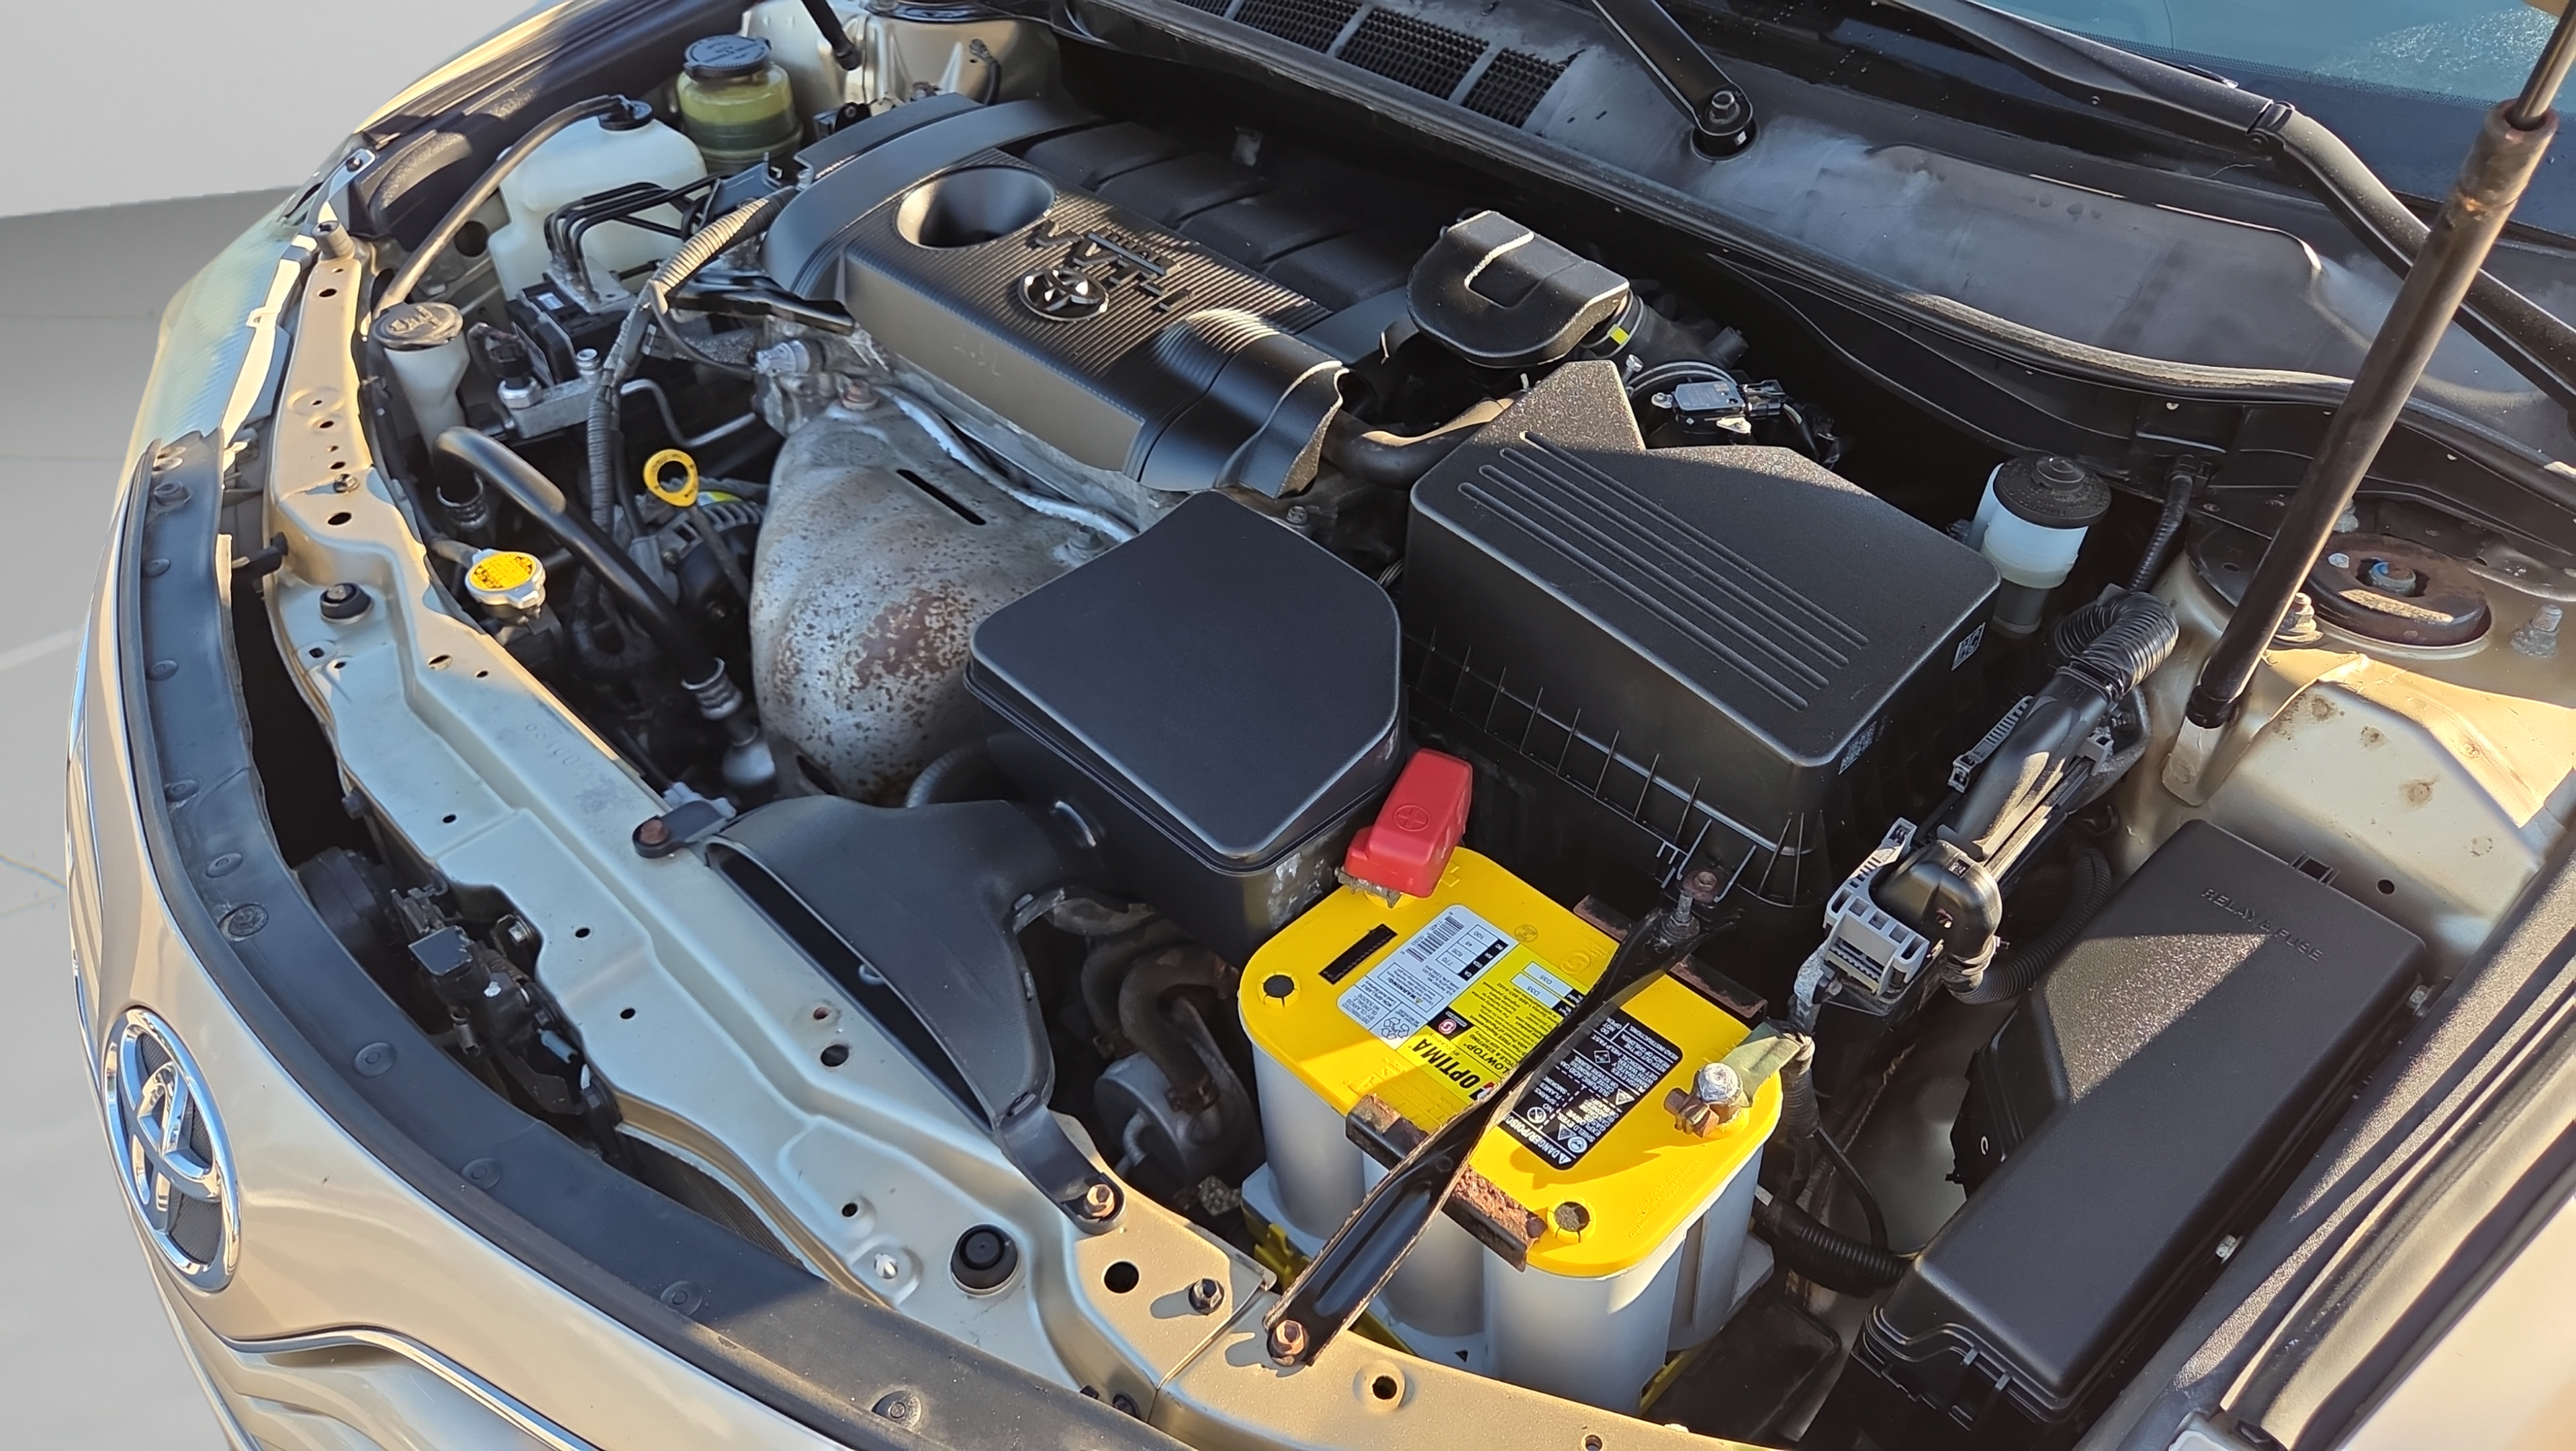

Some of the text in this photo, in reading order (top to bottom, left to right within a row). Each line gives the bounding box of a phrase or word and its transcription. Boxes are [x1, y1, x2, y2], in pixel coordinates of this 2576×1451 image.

[2200, 884, 2258, 925] RELAY
[2273, 926, 2324, 963] FUSE
[1473, 930, 1485, 939] 100
[1440, 956, 1454, 966] 770
[1451, 947, 1464, 957] 620
[1364, 980, 1380, 992] Battery
[1385, 977, 1417, 999] WARNING:
[1394, 977, 1416, 992] Reproductive
[1431, 980, 1446, 991] PATENT
[1538, 974, 1553, 985] D35
[1361, 983, 1393, 1007] NON-SPILLABLE
[1413, 985, 1424, 994] hands
[1471, 990, 1485, 1001] service
[1481, 981, 1521, 1008] originally purchased.
[1525, 985, 1540, 996] D35
[1345, 998, 1367, 1014] CLARIOS
[1350, 995, 1379, 1016] GLENDALE,
[1385, 996, 1396, 1004] Lead
[1421, 996, 1434, 1005] Cancer
[1484, 1000, 1503, 1013] warranty
[1485, 995, 1502, 1006] battery
[1487, 991, 1517, 1011] location where
[1500, 1004, 1514, 1014] return
[1340, 1002, 1371, 1024] DISTRIBUTED
[1476, 1012, 1500, 1029] Purchase.
[1525, 1015, 1540, 1026] receipt
[1528, 1012, 1547, 1026] purposes.
[1530, 1006, 1547, 1017] Service
[1468, 1014, 1499, 1036] Replacement
[1514, 1015, 1546, 1037] batteries.com
[1514, 1020, 1532, 1033] product
[1599, 1026, 1610, 1035] DO
[1602, 1021, 1616, 1032] NOT
[1427, 1032, 1453, 1051] CLARIOS
[1468, 1033, 1496, 1053] STARTING
[1473, 1030, 1491, 1043] Battery
[1497, 1034, 1512, 1045] FREE
[1503, 1031, 1518, 1042] Proof
[1516, 1041, 1528, 1049] with
[1627, 1024, 1679, 1061] READ INSTRUCTIONS.
[1462, 1039, 1510, 1074] LOWTOP®
[1590, 1032, 1659, 1081] GET MEDICAL HELP FAST.
[1619, 1032, 1671, 1069] REACH OF CHILDREN.
[1623, 1042, 1667, 1073] KEEP OUT OF THE
[1498, 1055, 1514, 1067] YCLE
[1568, 1066, 1584, 1079] ACID
[1569, 1059, 1615, 1093] CAUSE BLINDNESS
[1572, 1055, 1619, 1089] OR SEVERE BURNS.
[1610, 1060, 1651, 1089] IMMEDIATELY
[1610, 1067, 1647, 1093] FLUSH EYES
[1616, 1057, 1655, 1085] WITH WATER.
[1532, 1086, 1557, 1105] SPARKS
[1538, 1081, 1563, 1100] FLAMES
[1580, 1075, 1610, 1098] SULFURIC
[1541, 1102, 1555, 1113] NO
[1577, 1102, 1612, 1127] CAN CAUSE
[1582, 1098, 1616, 1123] BLINDNESS
[1588, 1095, 1620, 1118] OR INJURY.
[1554, 1111, 1597, 1143] SHIELD EYES.
[1564, 1108, 1603, 1137] EXPLOSIVE
[1582, 1113, 1607, 1132] GASES
